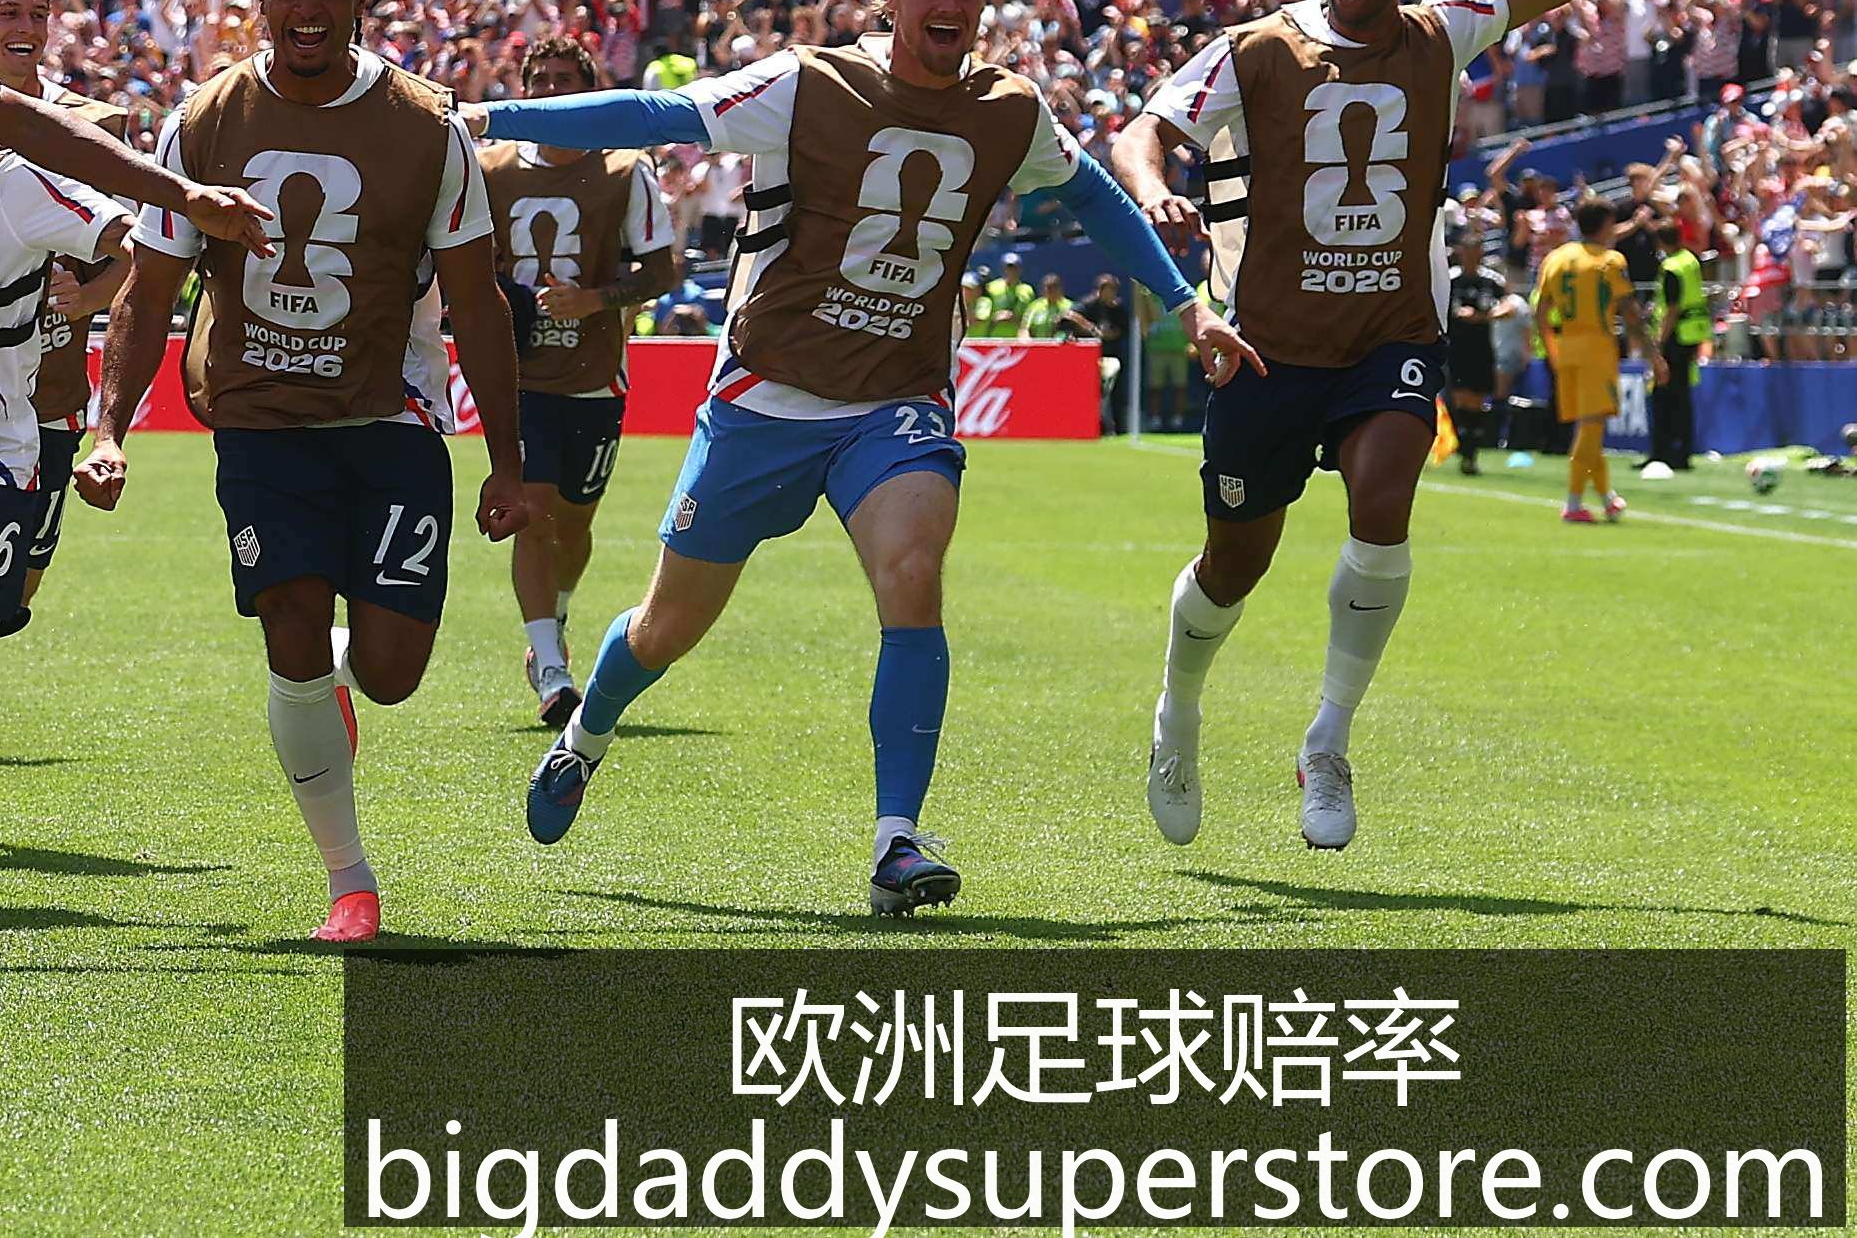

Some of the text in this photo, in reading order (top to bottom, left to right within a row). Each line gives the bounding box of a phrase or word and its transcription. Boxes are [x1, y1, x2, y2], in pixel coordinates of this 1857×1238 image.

[1334, 214, 1382, 232] FIFA
[869, 259, 917, 285] FIFA
[1302, 250, 1403, 267] WORLD CUP
[1301, 267, 1402, 294] 2026
[270, 291, 319, 314] FIFA
[824, 285, 925, 318] WORLD CUP
[1560, 272, 1576, 320] 5
[554, 318, 581, 329] CUP
[811, 302, 913, 340] 2026
[243, 322, 347, 352] WORLD CUP
[530, 329, 580, 348] 026
[241, 341, 344, 378] 2026
[1400, 358, 1427, 387] 6
[585, 439, 618, 482] 10
[372, 504, 439, 576] 12
